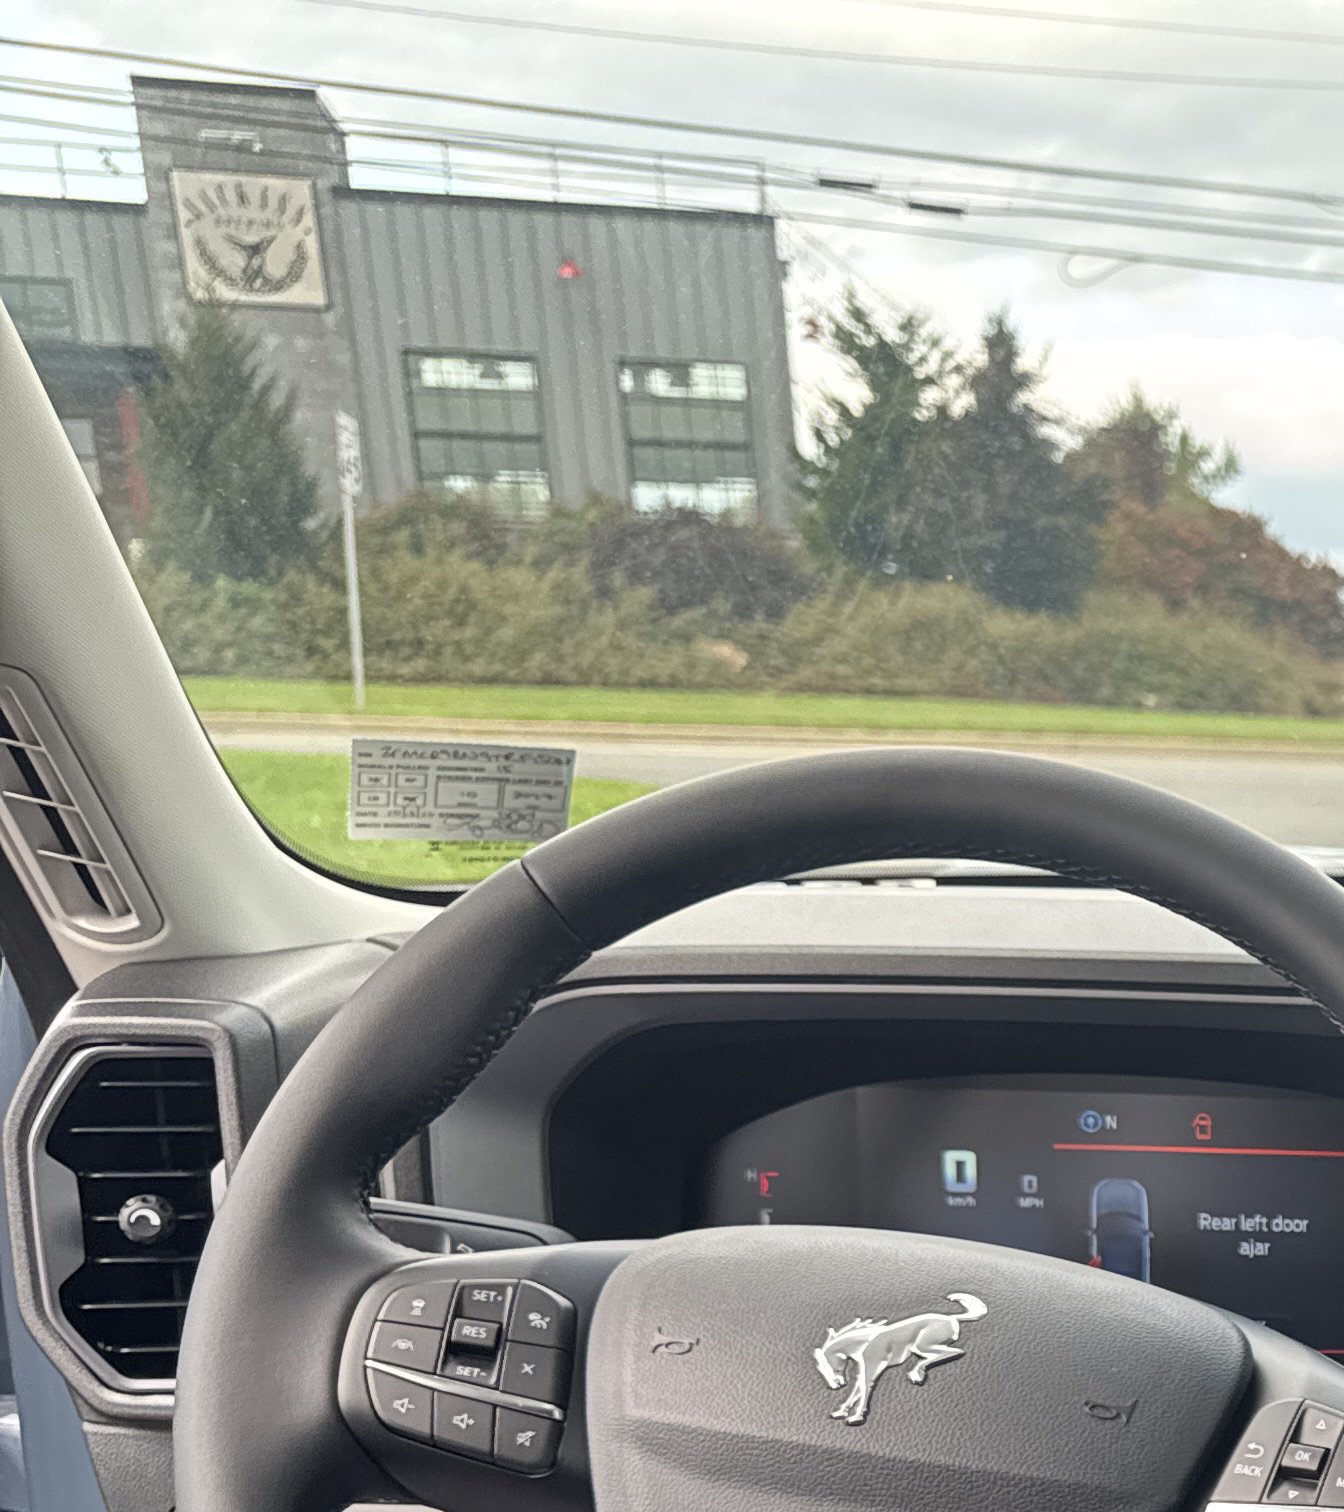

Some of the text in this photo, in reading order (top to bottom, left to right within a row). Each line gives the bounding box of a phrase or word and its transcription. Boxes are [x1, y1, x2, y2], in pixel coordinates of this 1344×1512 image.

[1104, 1115, 1118, 1130] N
[1017, 1197, 1044, 1209] MPH
[1198, 1213, 1309, 1233] Rear left door
[1238, 1239, 1271, 1258] ajar
[462, 1325, 487, 1338] RES
[1295, 1451, 1311, 1462] OK
[1234, 1464, 1263, 1477] BACK
